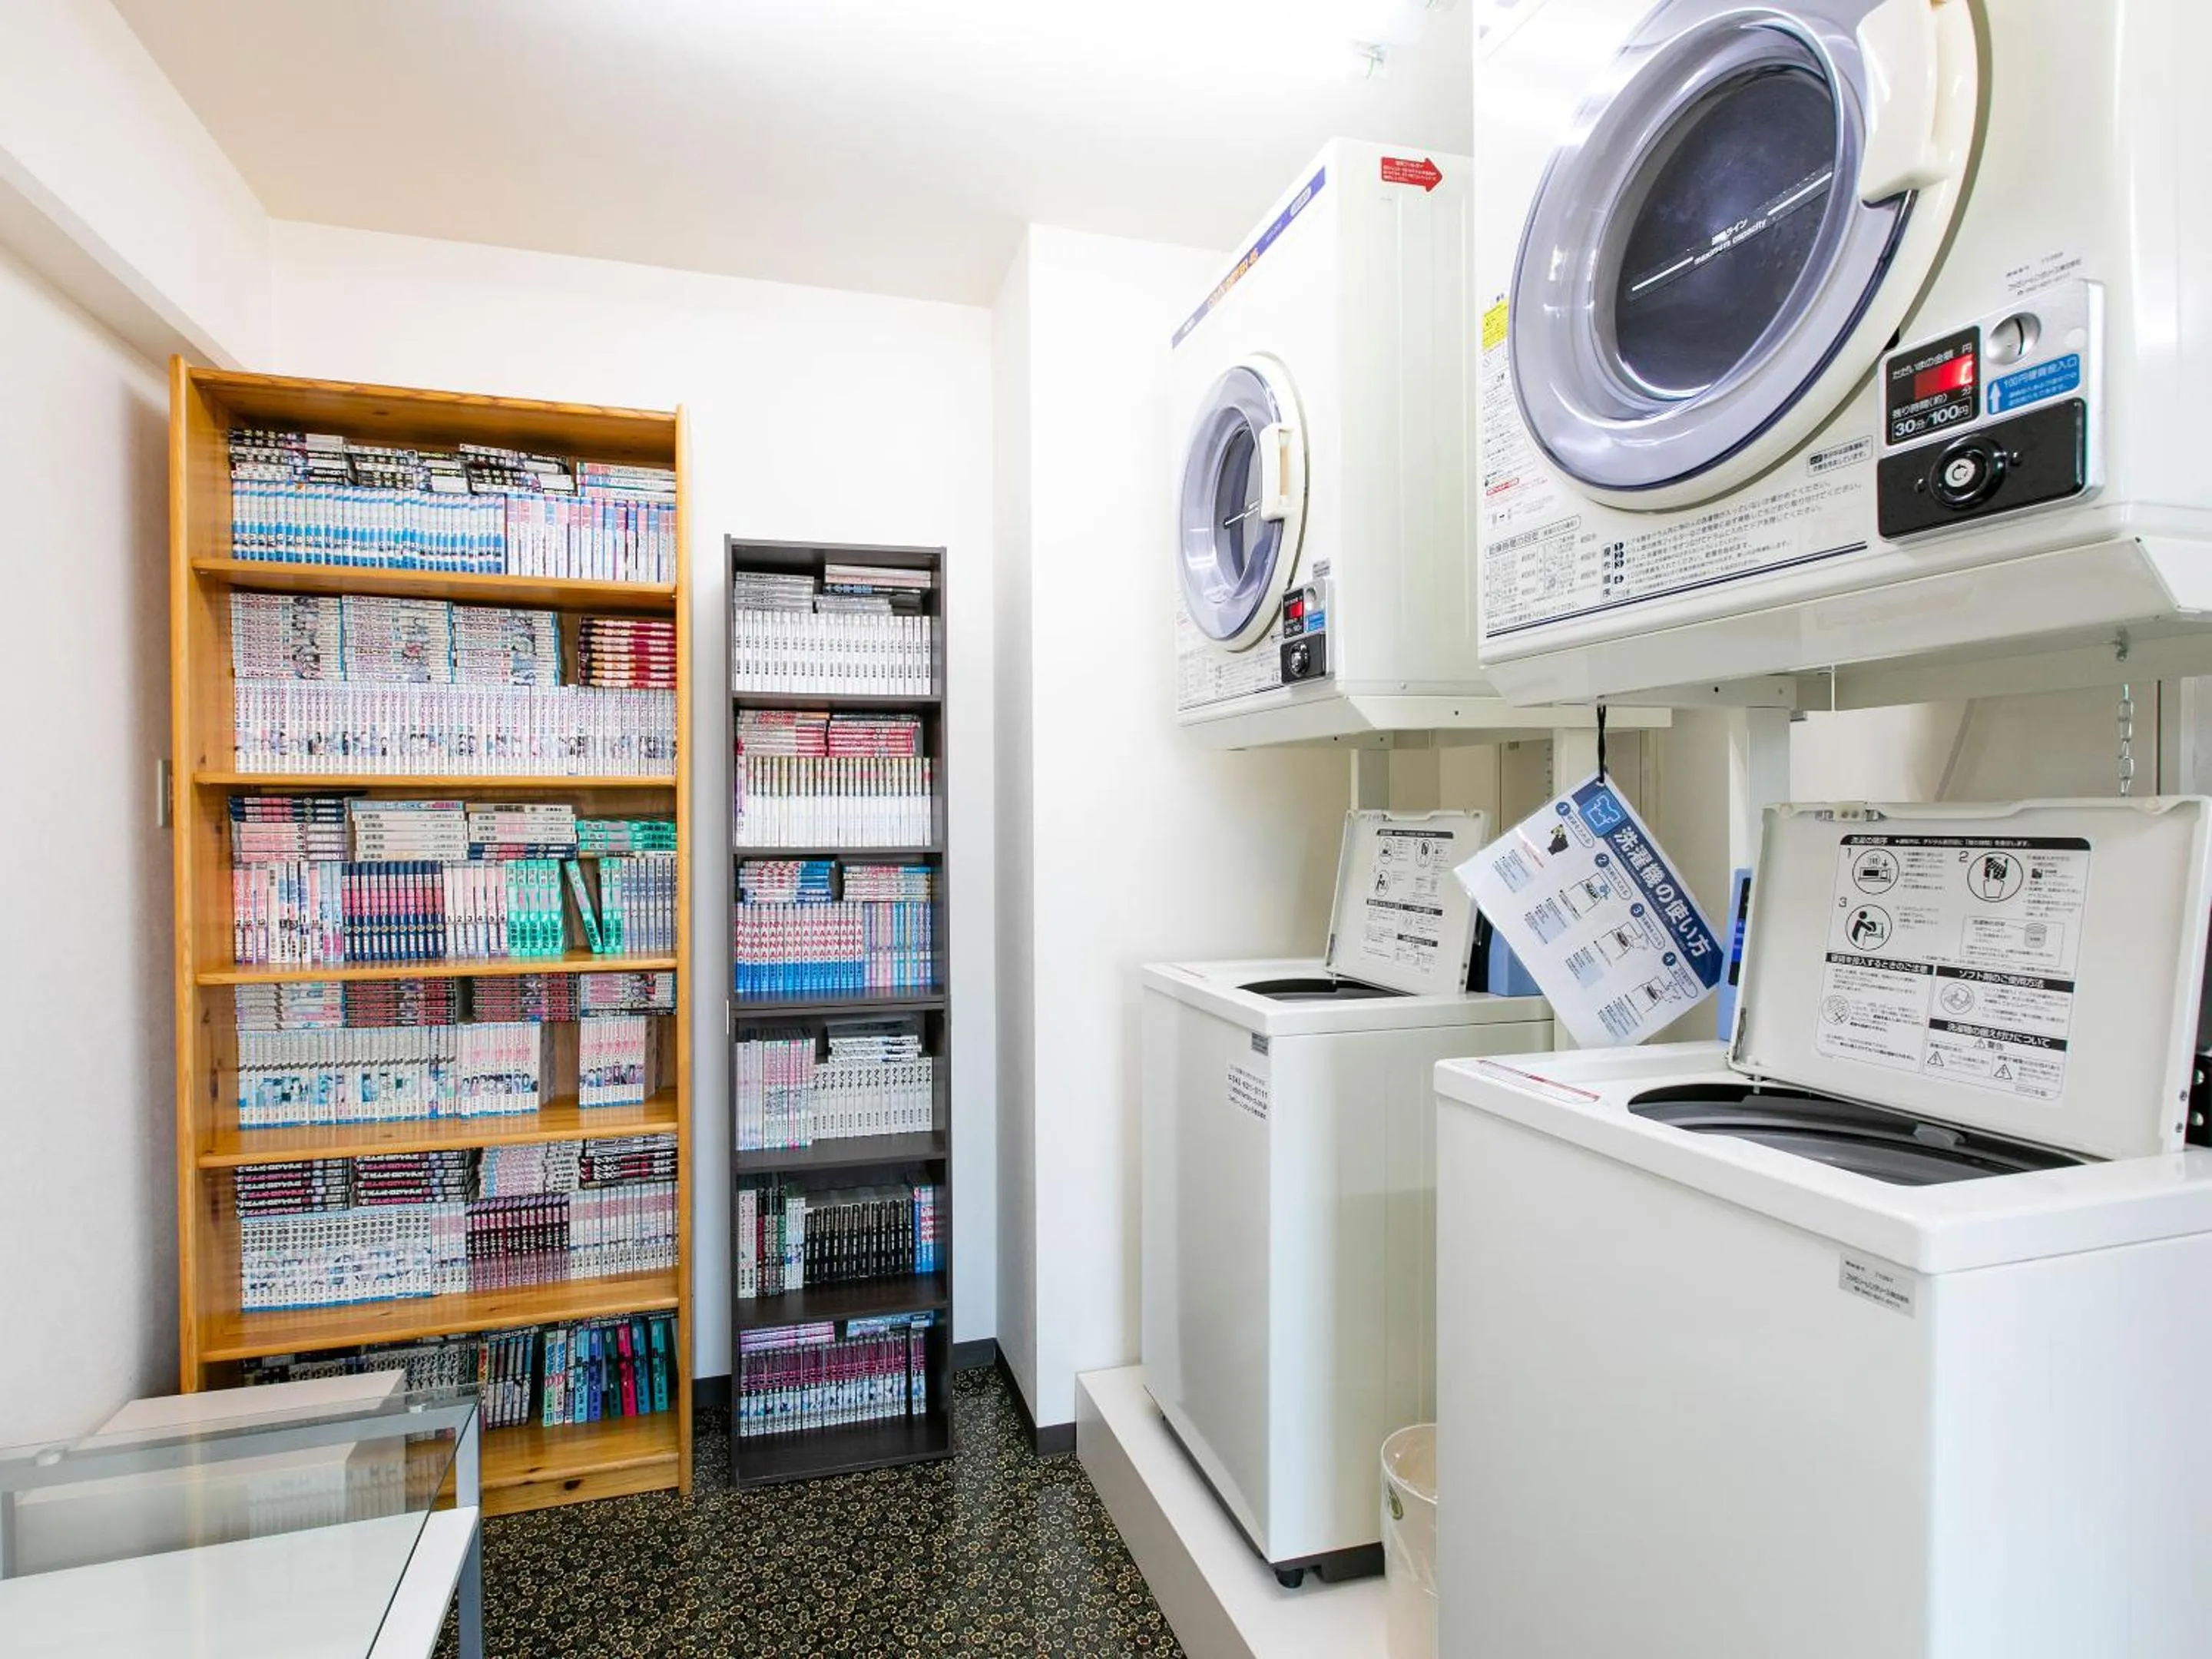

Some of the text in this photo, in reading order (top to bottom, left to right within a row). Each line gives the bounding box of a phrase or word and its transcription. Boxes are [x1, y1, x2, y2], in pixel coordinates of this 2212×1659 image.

[1894, 404, 1969, 437] 30分/100円
[1846, 848, 1852, 859] 1
[1959, 851, 1969, 863] 2
[1614, 826, 1712, 958] 洗濯機の使い方
[1839, 897, 1847, 908] 3
